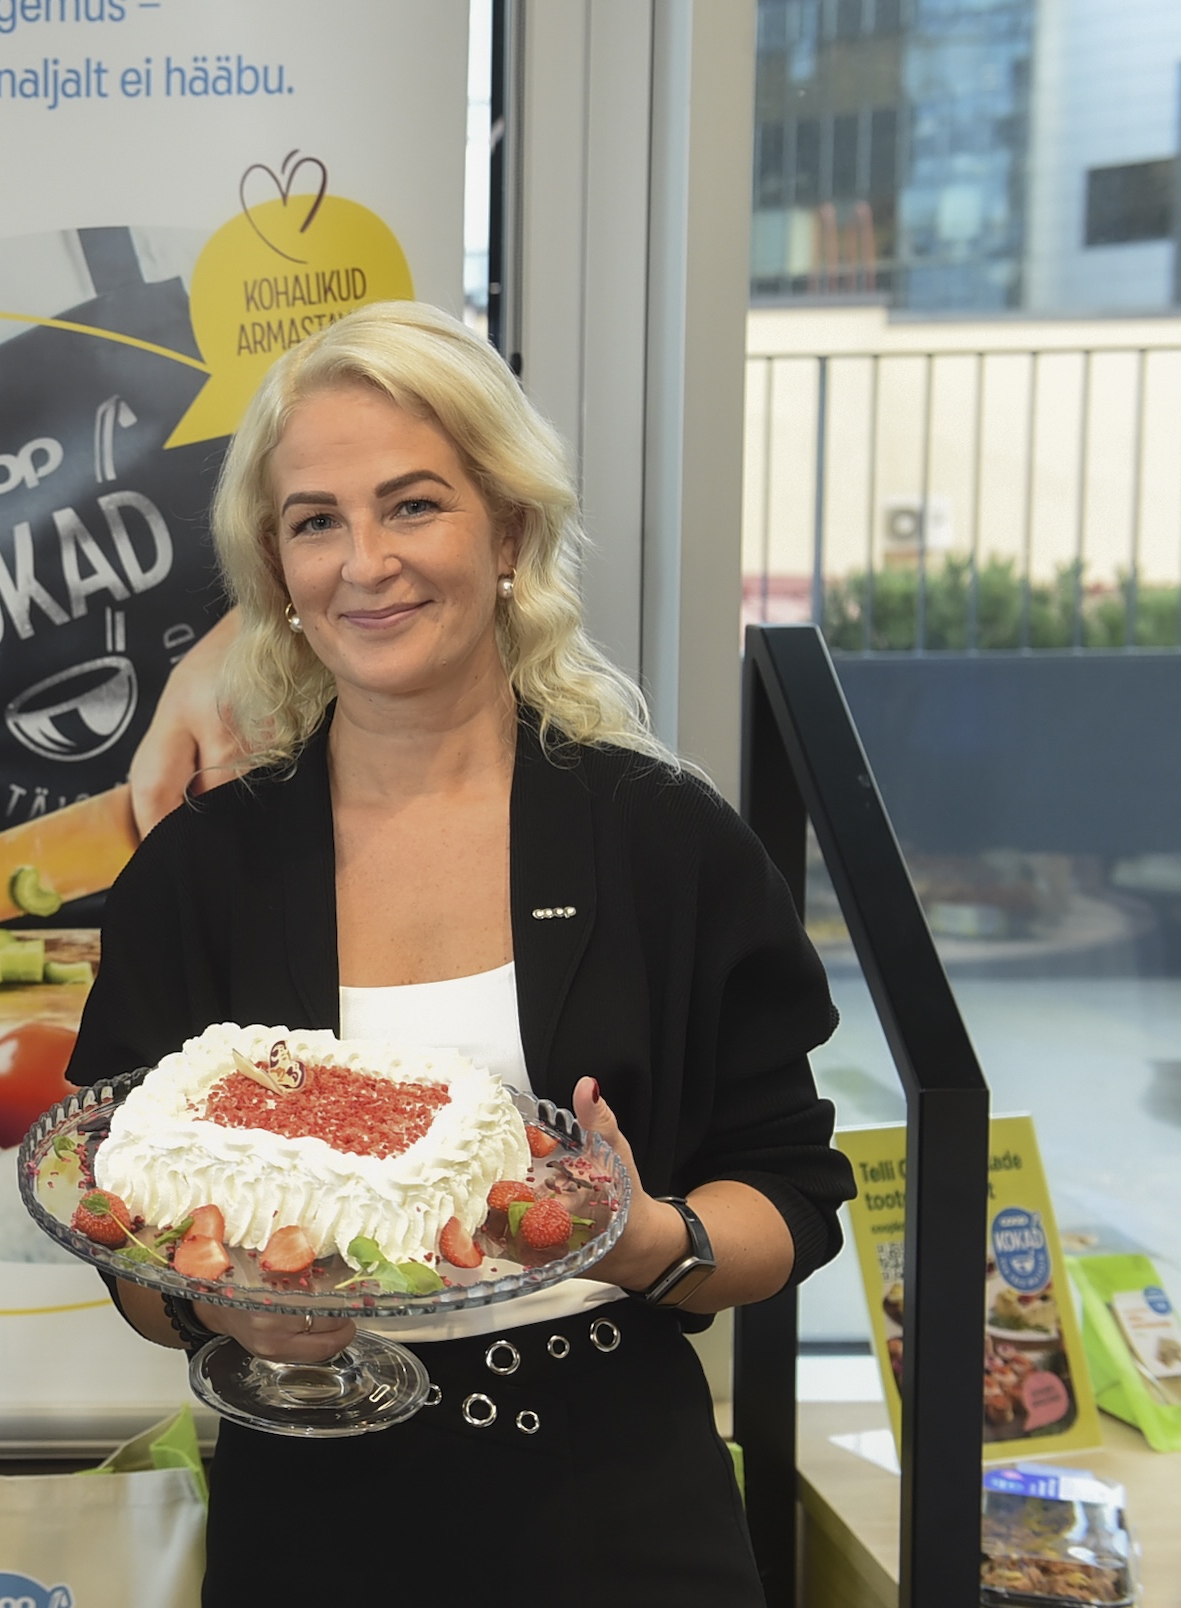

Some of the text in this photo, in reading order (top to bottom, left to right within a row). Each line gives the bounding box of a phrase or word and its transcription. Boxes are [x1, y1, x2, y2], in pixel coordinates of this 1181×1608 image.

[120, 57, 152, 97] ei
[165, 55, 294, 98] hääbu.
[243, 267, 367, 312] KOHALIKUD
